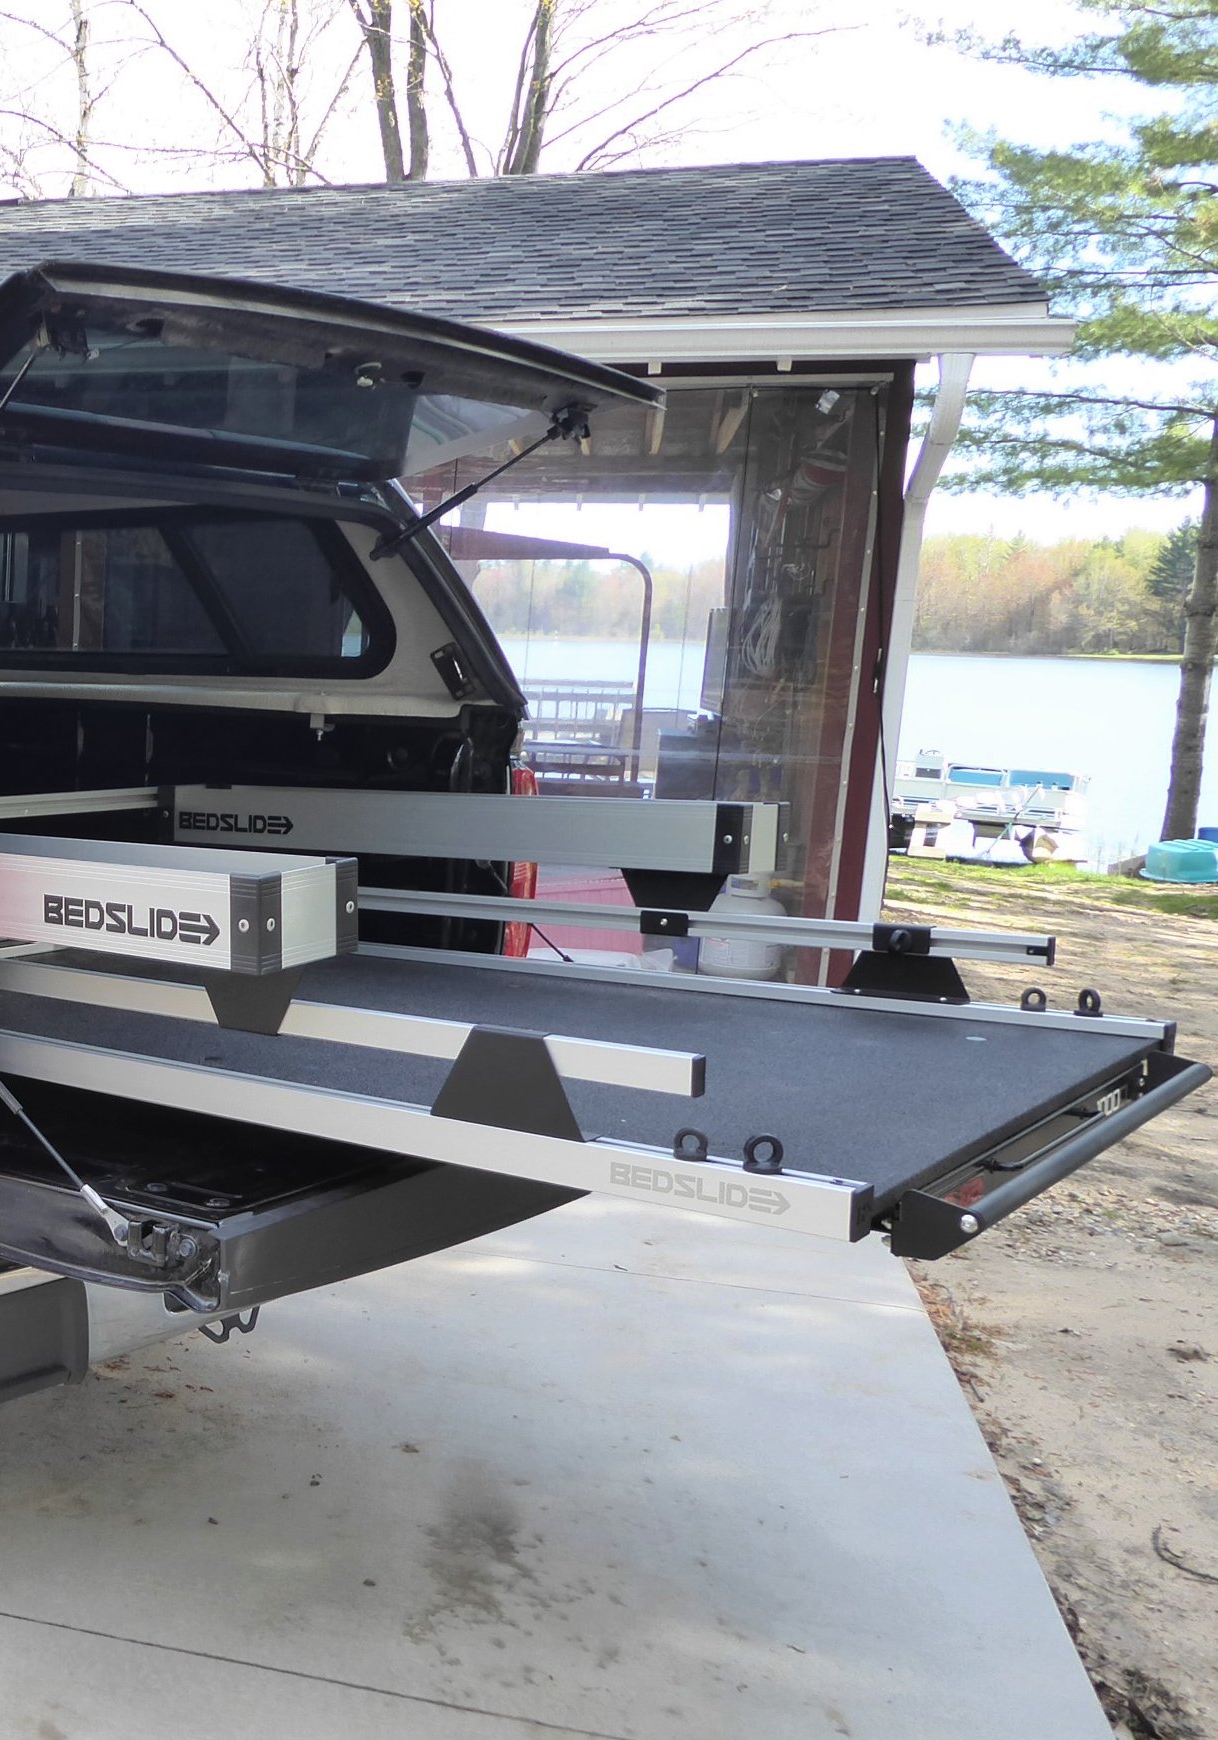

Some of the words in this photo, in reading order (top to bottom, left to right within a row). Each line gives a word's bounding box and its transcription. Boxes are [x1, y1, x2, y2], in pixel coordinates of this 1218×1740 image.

[179, 811, 293, 835] BEDSLIDE
[44, 894, 220, 946] BEDSLIDE
[610, 1162, 791, 1216] BEDSLIDE
